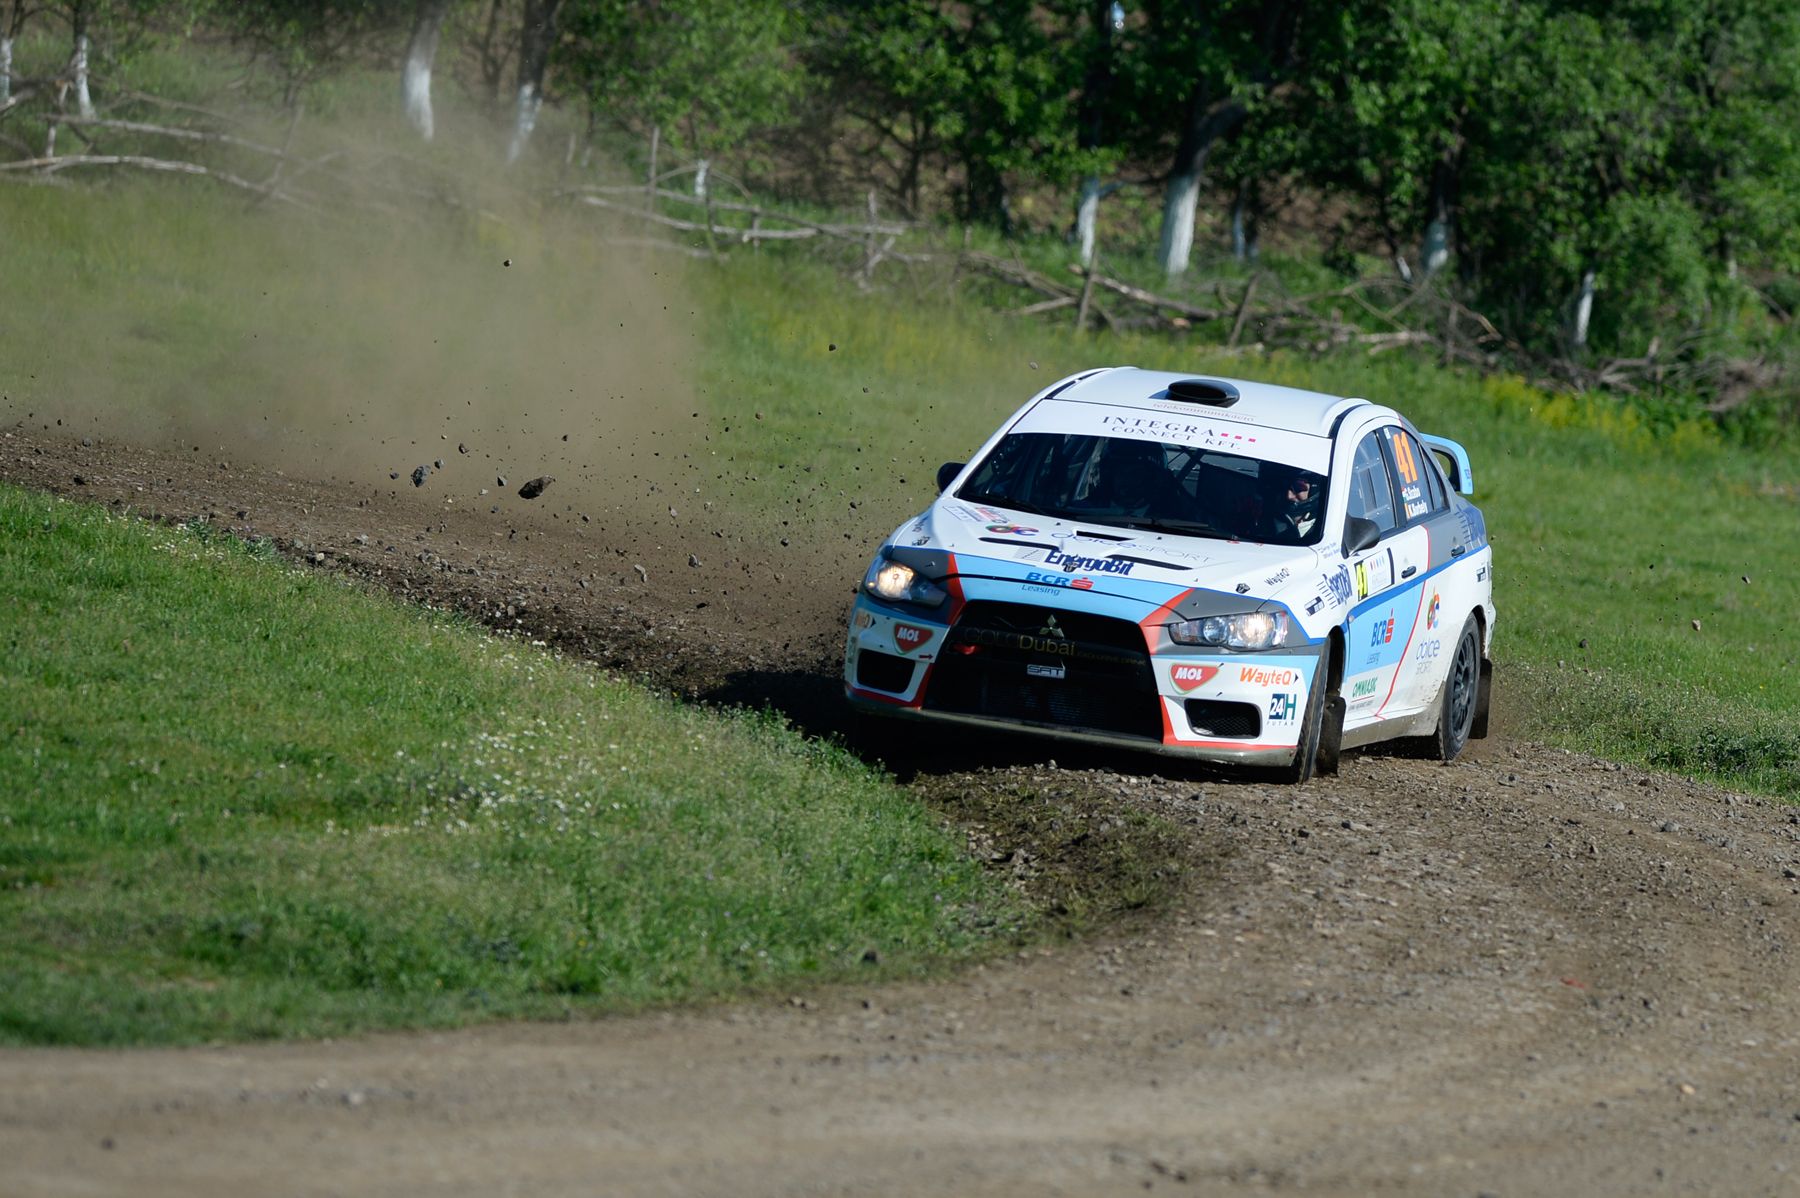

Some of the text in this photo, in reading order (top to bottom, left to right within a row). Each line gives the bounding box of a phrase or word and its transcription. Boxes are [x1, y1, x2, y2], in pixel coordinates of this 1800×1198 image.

[1102, 416, 1215, 437] INTEGRA
[1111, 426, 1196, 442] CONNECT
[1393, 431, 1418, 484] 41
[1025, 572, 1070, 588] BCR
[1021, 584, 1060, 597] Leasing
[896, 626, 919, 643] MOL
[1370, 619, 1388, 648] BCR
[1019, 634, 1077, 657] Dubai
[1174, 666, 1203, 681] MOL
[1239, 667, 1292, 687] WayteQ
